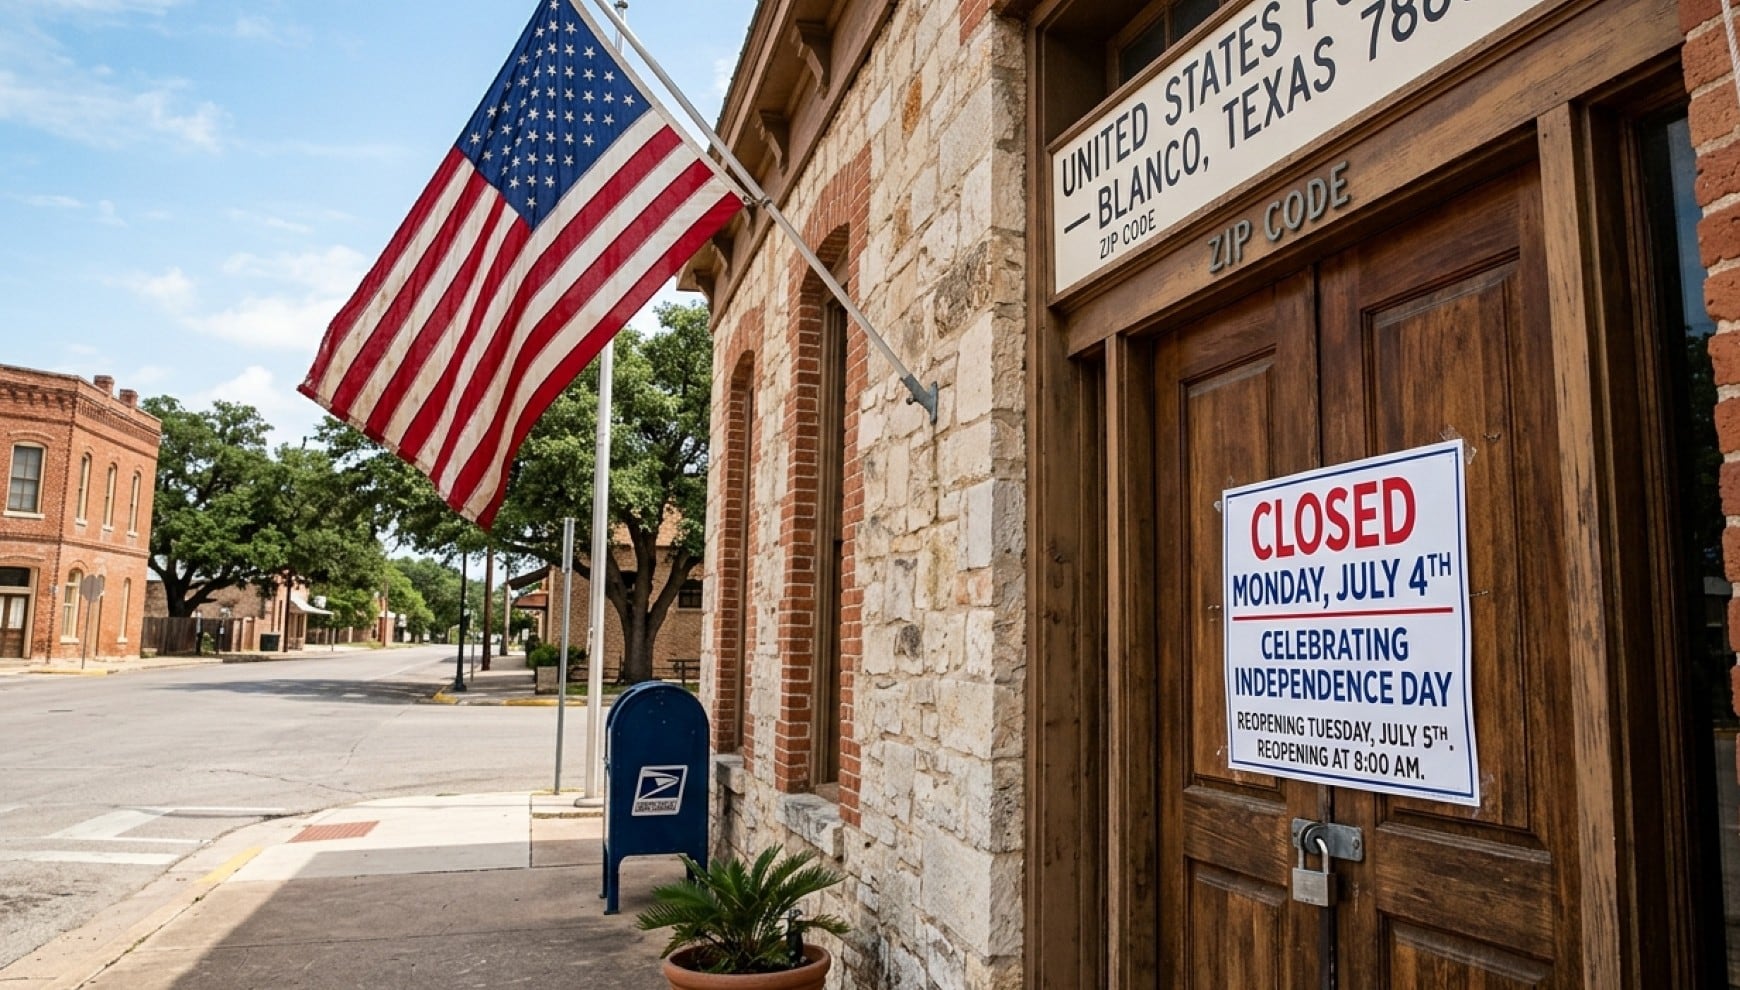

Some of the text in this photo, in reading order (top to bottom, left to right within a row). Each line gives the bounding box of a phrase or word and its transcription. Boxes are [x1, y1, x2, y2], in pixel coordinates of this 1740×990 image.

[1062, 0, 1282, 197] UNITED STATES
[1098, 127, 1209, 229] BLANCO,
[1222, 36, 1336, 149] TEXAS
[1100, 208, 1157, 260] ZIP CODE
[1208, 161, 1349, 272] ZIP CODE
[1251, 476, 1416, 560] CLOSED
[1233, 551, 1452, 608] MONDAY, JULY 4TH
[1261, 627, 1409, 662] CELEBRATING
[1235, 667, 1452, 707] INDEPENDENCE DAY
[1237, 711, 1305, 736] REOPENING
[1307, 717, 1375, 747] TUESDAY,
[1379, 723, 1417, 747] JULY
[1257, 739, 1425, 780] REOPENING AT 8:00 AM.
